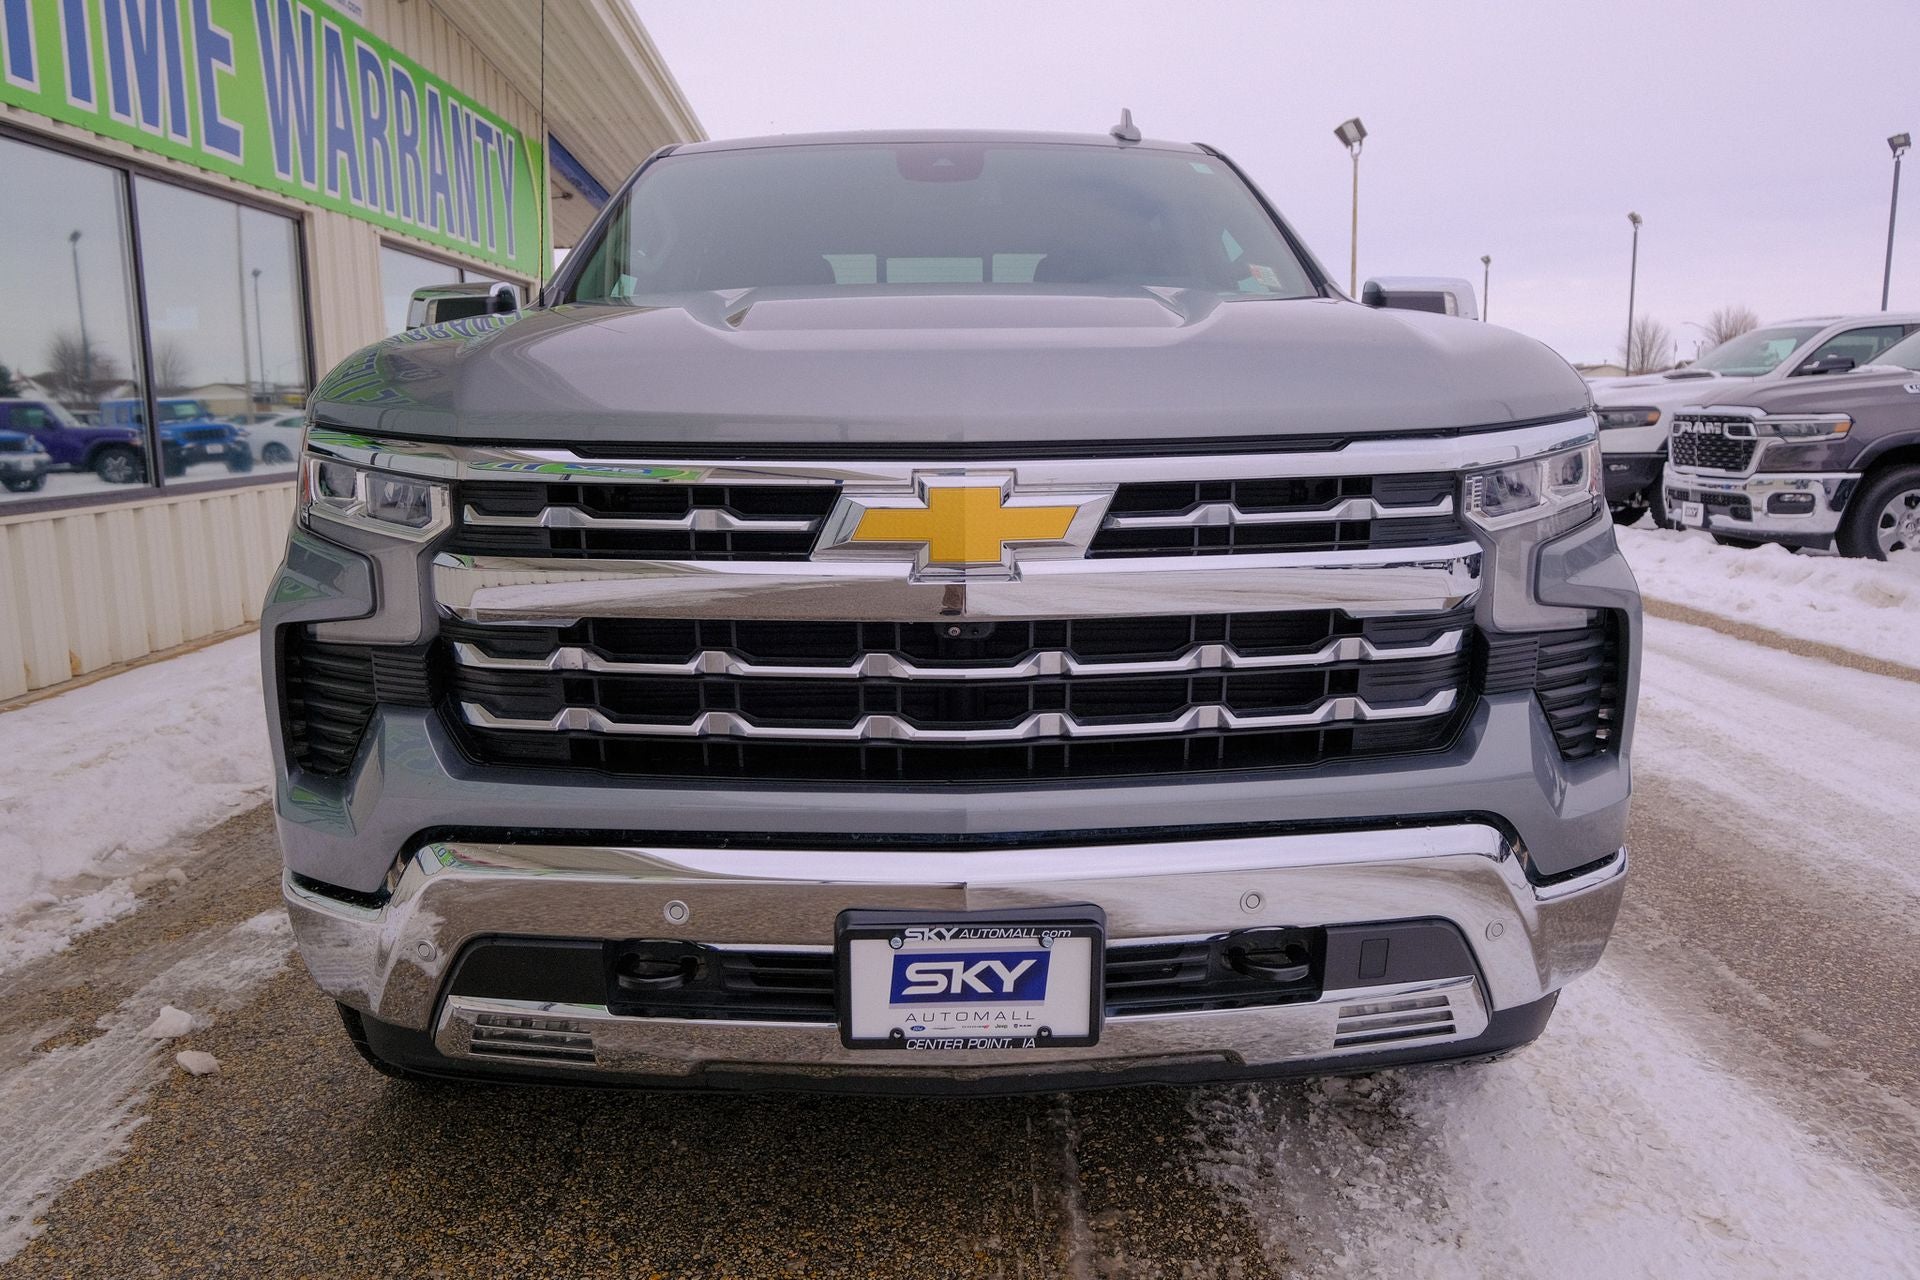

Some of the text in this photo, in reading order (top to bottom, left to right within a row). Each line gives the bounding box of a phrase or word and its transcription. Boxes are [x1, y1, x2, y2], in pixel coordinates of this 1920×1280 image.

[252, 0, 516, 260] WARRANTY
[1680, 421, 1722, 434] RAM
[904, 928, 1071, 942] SKY AUTOMALL.com
[901, 959, 1037, 995] SKY
[905, 1011, 1035, 1022] AUTOMALL
[906, 1040, 963, 1050] CENTER
[1022, 1038, 1036, 1048] IA
